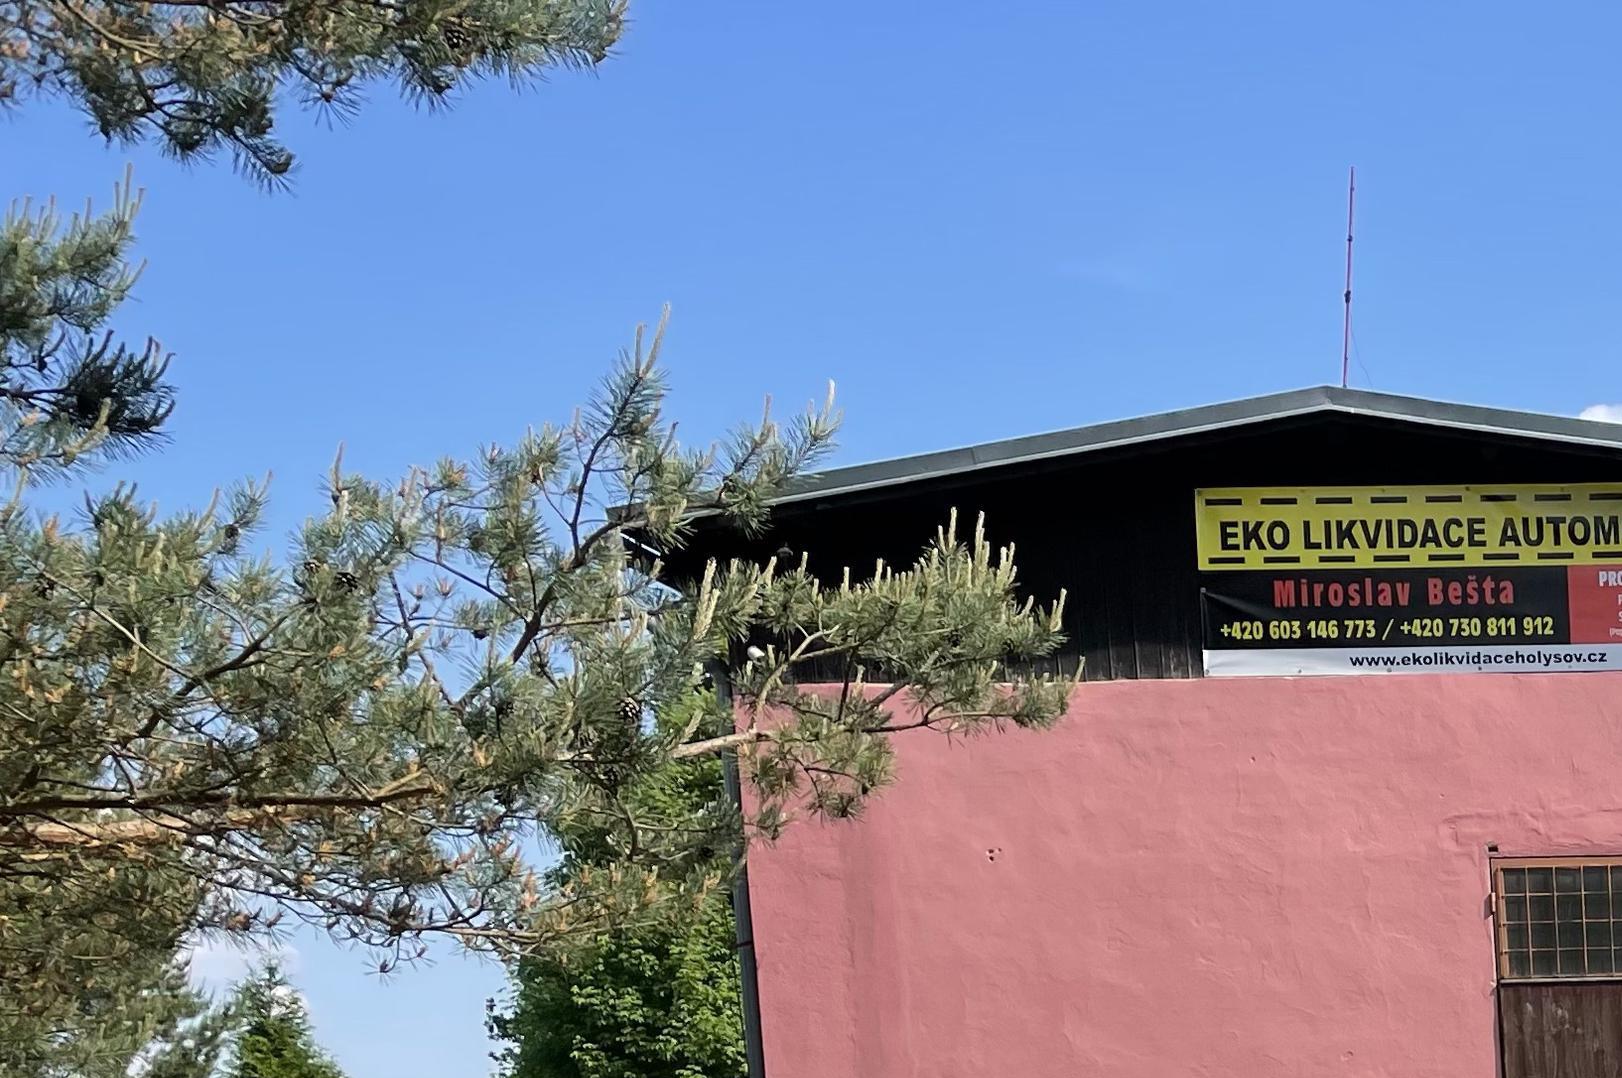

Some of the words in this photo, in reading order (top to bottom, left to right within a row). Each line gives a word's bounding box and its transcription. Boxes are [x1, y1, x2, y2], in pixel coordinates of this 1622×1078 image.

[1219, 520, 1290, 551] EKO
[1303, 517, 1487, 550] LIKVIDACE
[1273, 578, 1410, 608] Miroslav
[1427, 575, 1515, 606] Bešta
[1220, 621, 1264, 640] +420
[1269, 620, 1301, 639] 603
[1306, 620, 1339, 639] 146
[1344, 619, 1376, 638] 773
[1382, 618, 1395, 641] /
[1400, 618, 1444, 637] +420
[1449, 617, 1482, 636] 730
[1487, 617, 1516, 636] 811
[1523, 616, 1554, 635] 912
[1349, 650, 1608, 667] www.ekolikvidaceholysov.cz
